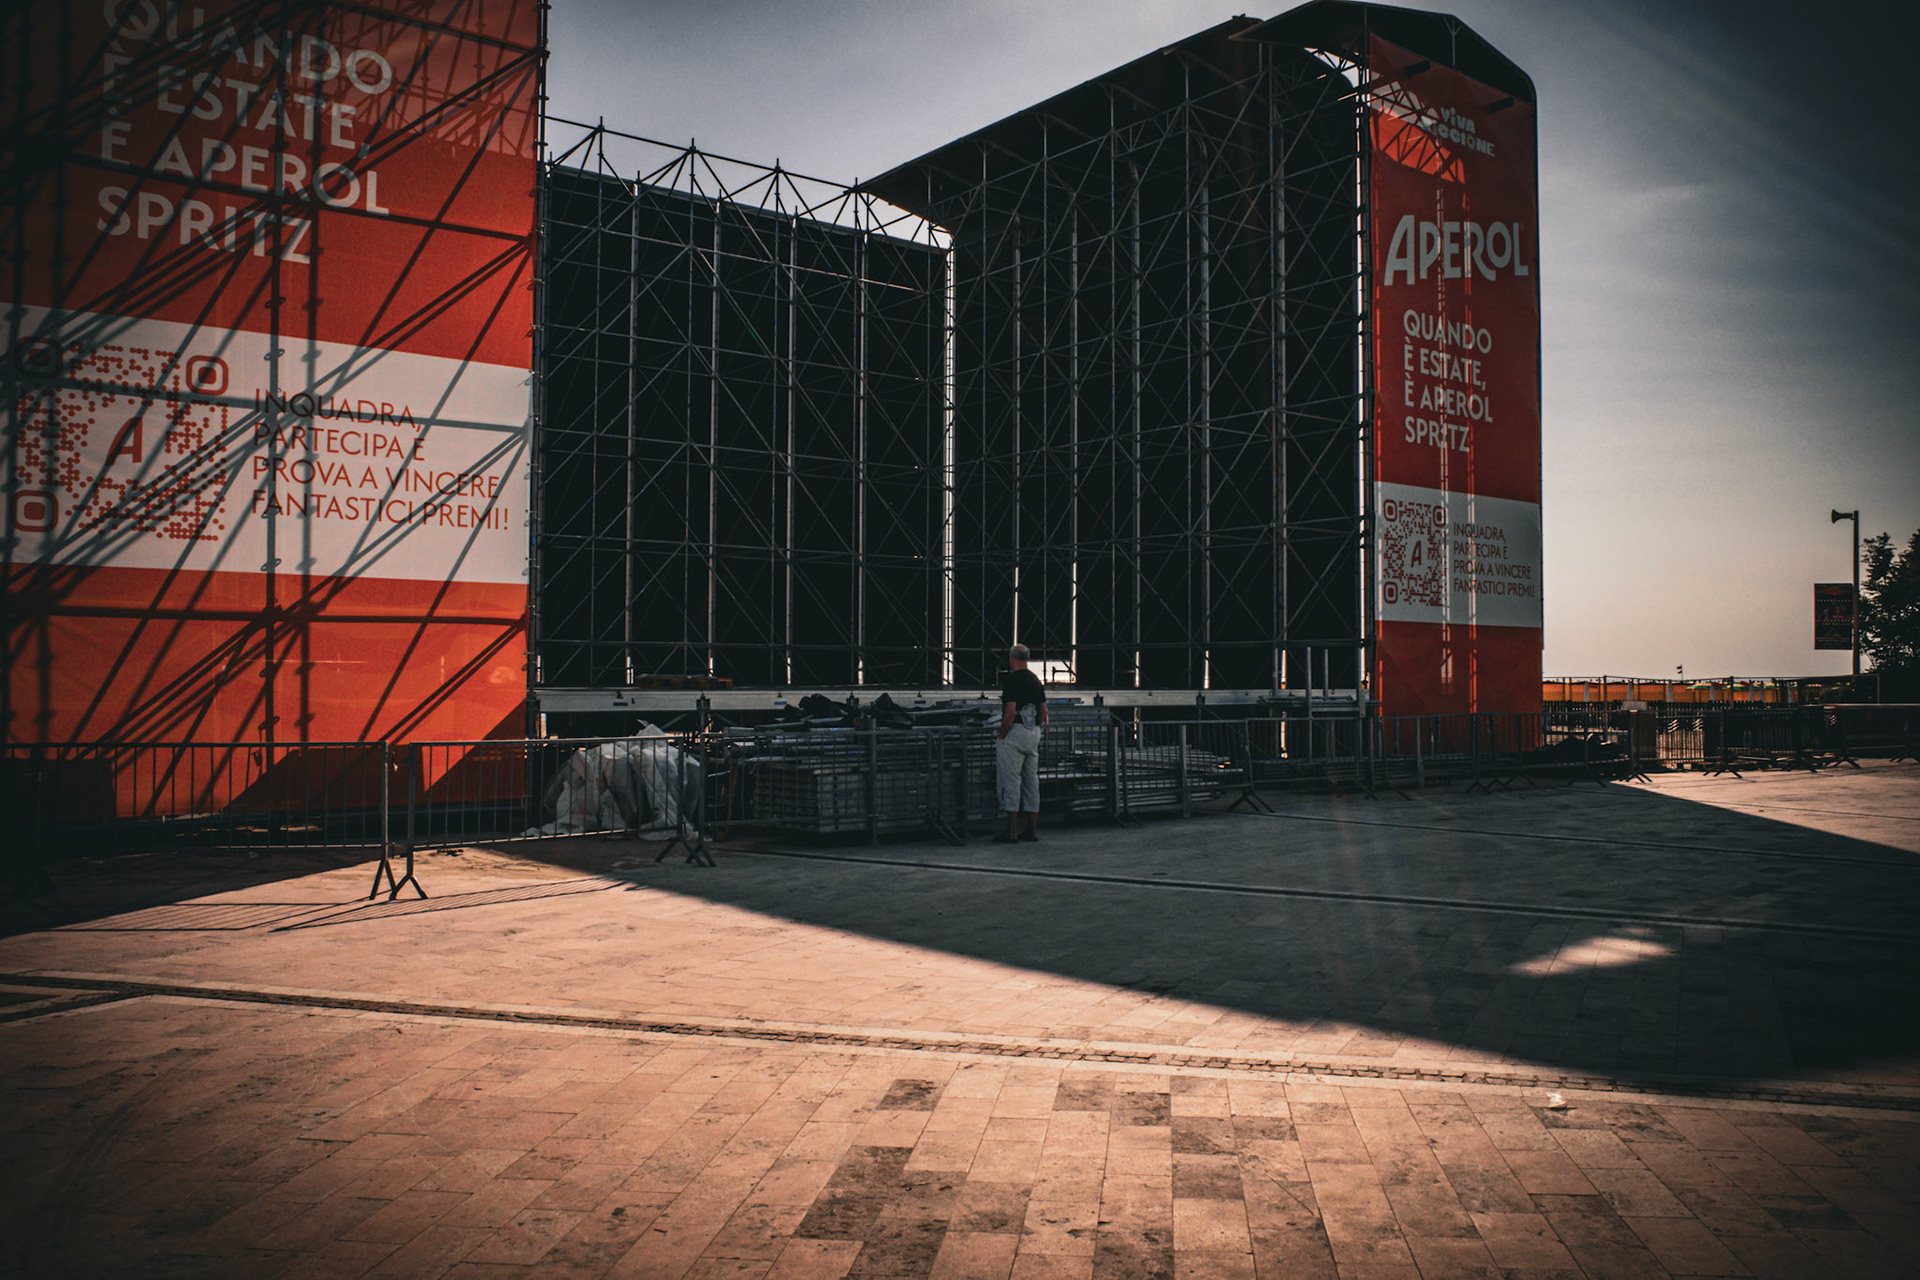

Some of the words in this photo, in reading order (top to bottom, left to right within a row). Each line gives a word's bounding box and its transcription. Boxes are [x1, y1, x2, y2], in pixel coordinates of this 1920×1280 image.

[103, 0, 392, 95] QUANDO
[156, 65, 370, 159] ESTATE,
[152, 133, 390, 216] APEROL
[97, 186, 312, 265] SPRITZ
[1383, 214, 1529, 286] APEROL
[1403, 309, 1492, 354] QUANDO
[1403, 336, 1414, 371] È
[1420, 347, 1486, 391] ESTATE,
[254, 388, 422, 432] INQUADRA,
[1404, 372, 1415, 407] È
[1420, 384, 1493, 423] APEROL
[254, 422, 405, 459] PARTECIPA
[413, 437, 425, 461] E
[1404, 416, 1470, 452] SPRITZ
[253, 456, 352, 488] PROVA
[359, 466, 379, 490] A
[386, 467, 500, 499] VINCERE
[252, 489, 414, 525] FANTASTICI
[422, 502, 510, 531] PREMI!
[1453, 522, 1507, 543] INQUADRA,
[1453, 541, 1502, 560] PARTECIPA
[1453, 559, 1485, 577] PROVA
[1486, 562, 1494, 577] A
[1494, 563, 1531, 580] VINCERE
[1453, 578, 1506, 596] FANTASTICI
[1507, 582, 1535, 598] PREMI!
